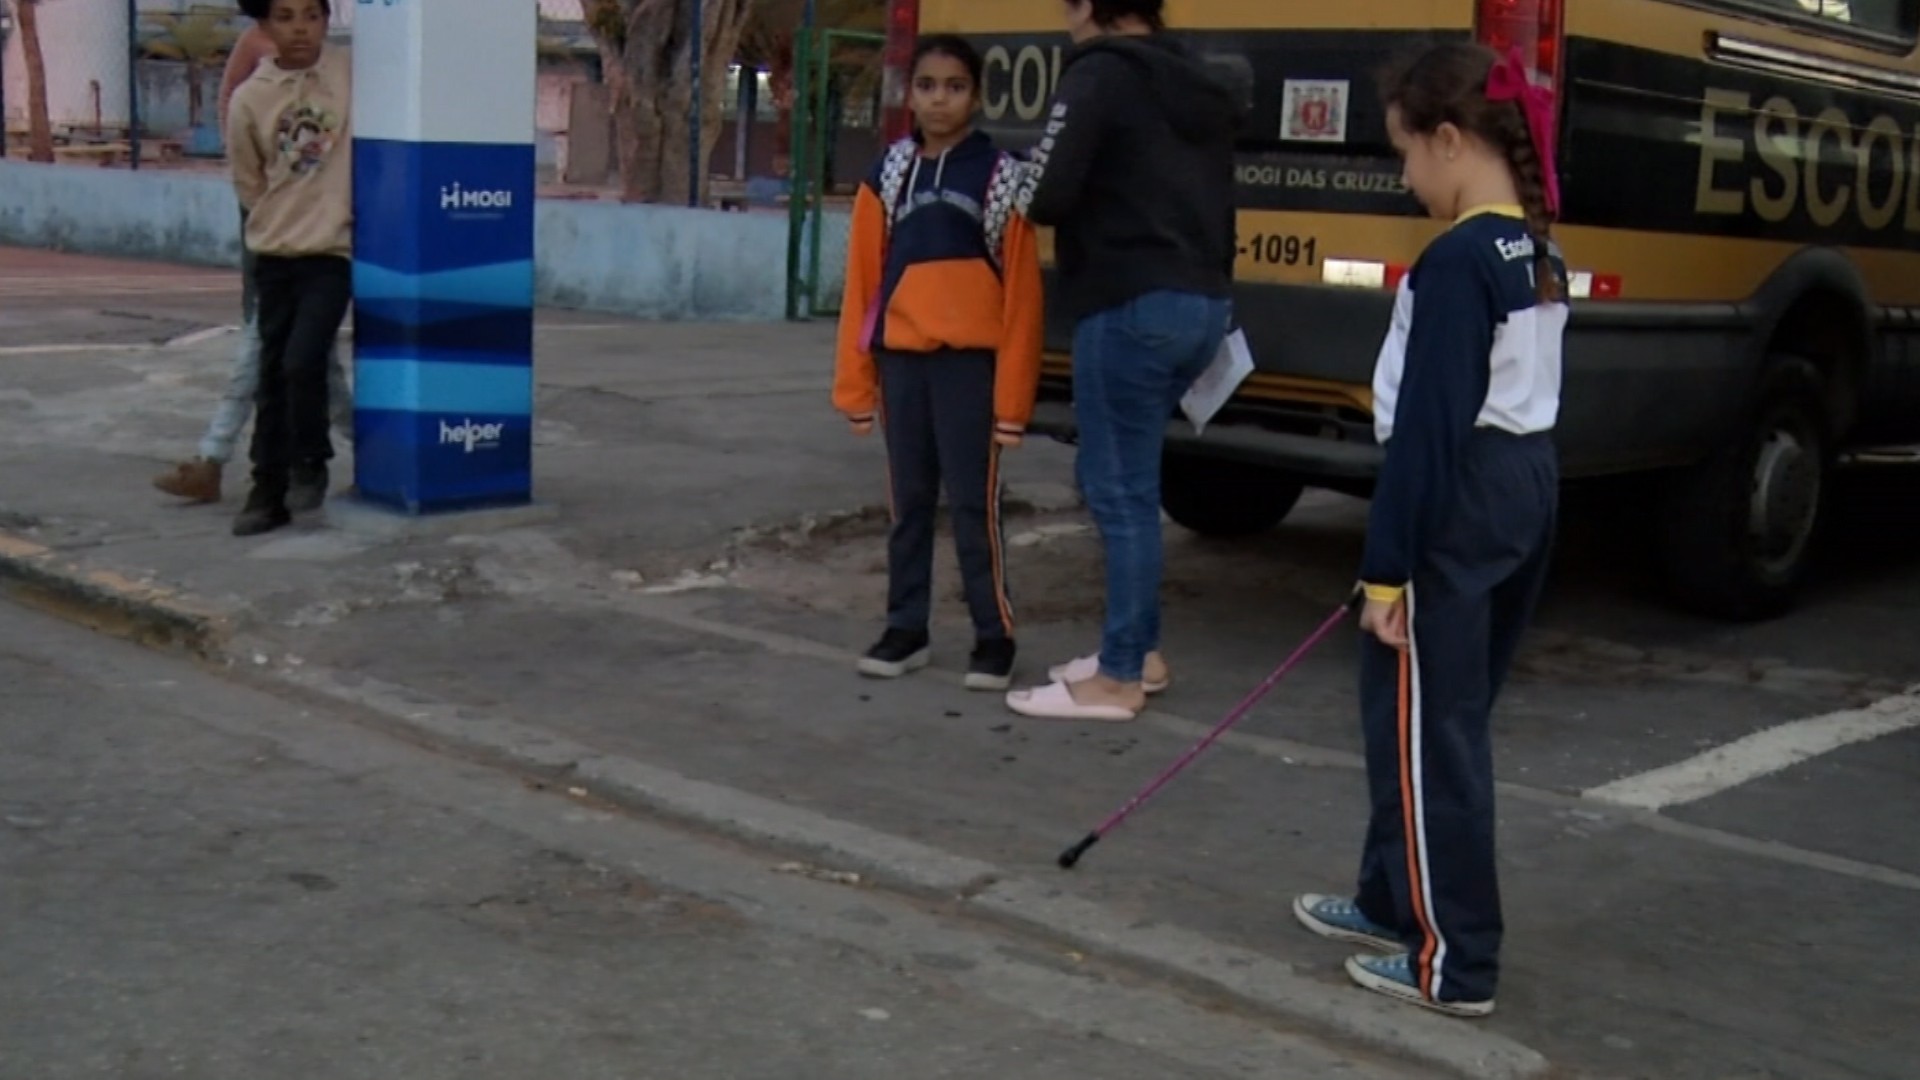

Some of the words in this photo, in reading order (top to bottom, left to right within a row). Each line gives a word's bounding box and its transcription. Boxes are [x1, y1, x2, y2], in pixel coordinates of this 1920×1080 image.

[1286, 168, 1327, 188] DAS
[462, 190, 512, 208] MOGI
[439, 417, 504, 453] helper
